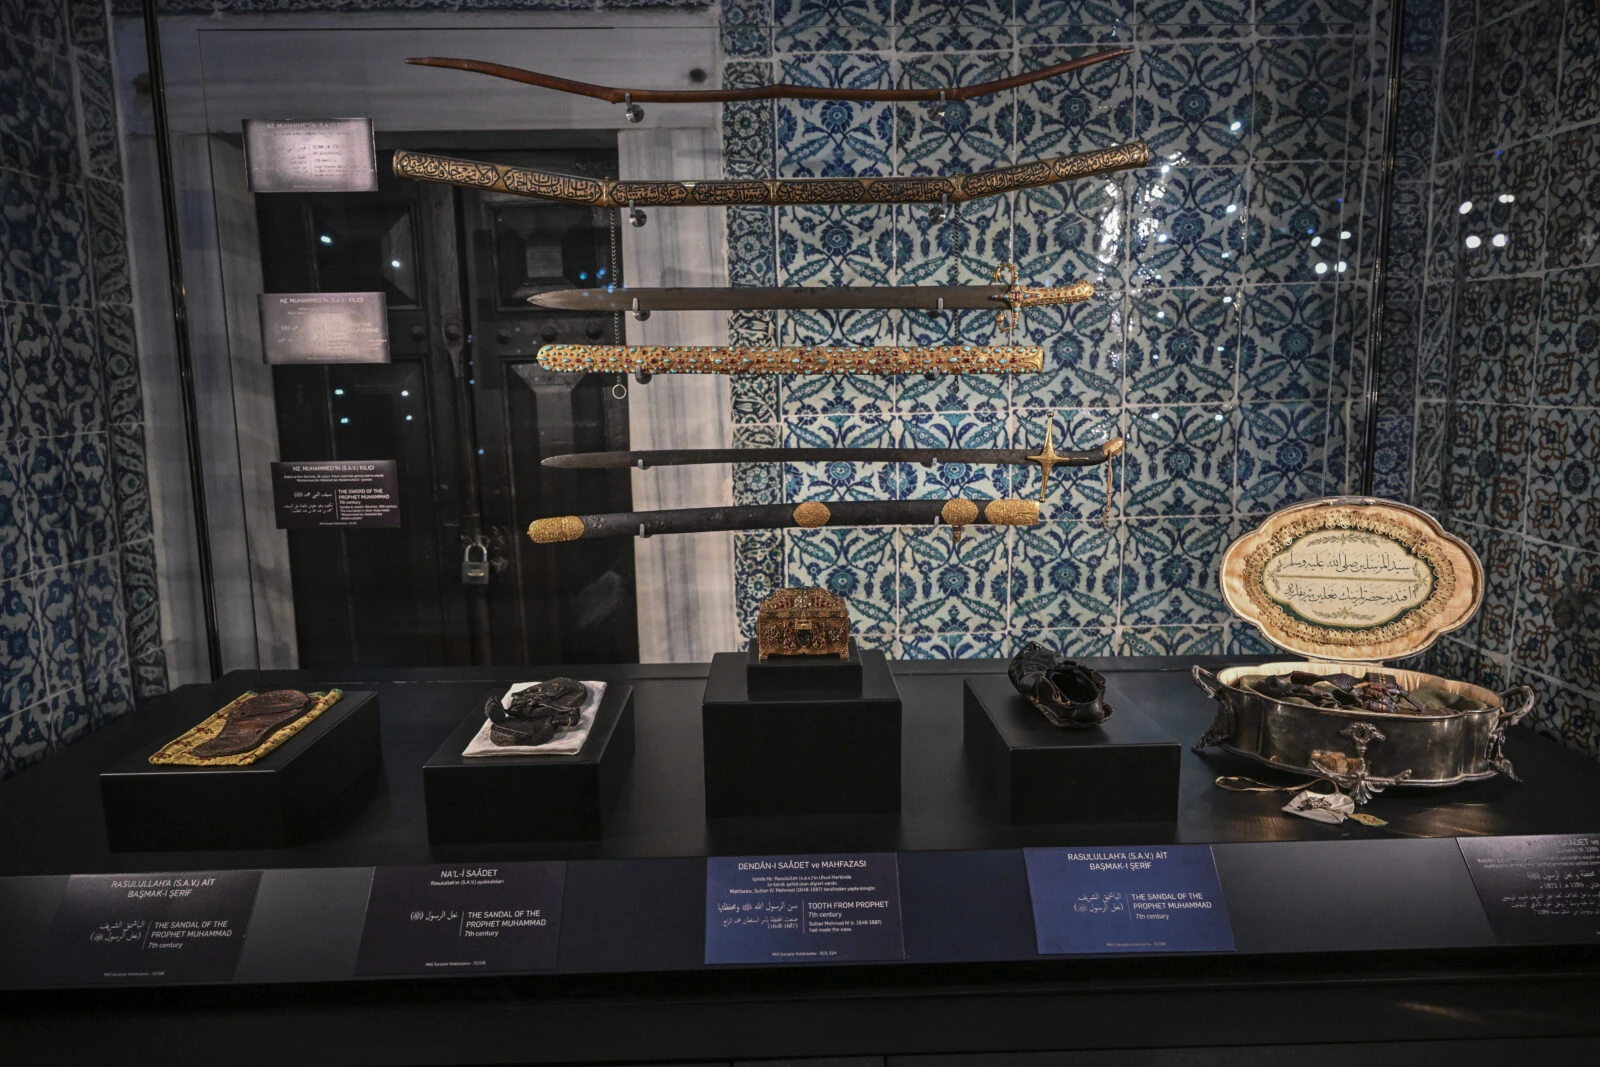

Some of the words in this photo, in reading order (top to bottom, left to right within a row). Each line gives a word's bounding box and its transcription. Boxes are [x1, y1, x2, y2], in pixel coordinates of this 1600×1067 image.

[1068, 853, 1126, 861] RASULULLAH'A
[1128, 852, 1154, 860] (S.A.V.)
[1156, 851, 1168, 859] AİT
[821, 860, 866, 868] MAHFAZASI
[1090, 862, 1128, 871] BAŞMAK-I
[1130, 861, 1152, 871] ŞERİF
[112, 880, 172, 888] RASULULLAH'A
[174, 879, 200, 887] (S.A.V.)
[202, 878, 215, 886] AİT
[128, 890, 167, 899] BAŞMAK-I
[169, 888, 192, 898] ŞERİF
[1133, 902, 1166, 910] PROPHET
[214, 920, 228, 928] THE
[502, 919, 546, 927] MUHAMMAD
[187, 929, 232, 937] MUHAMMAD
